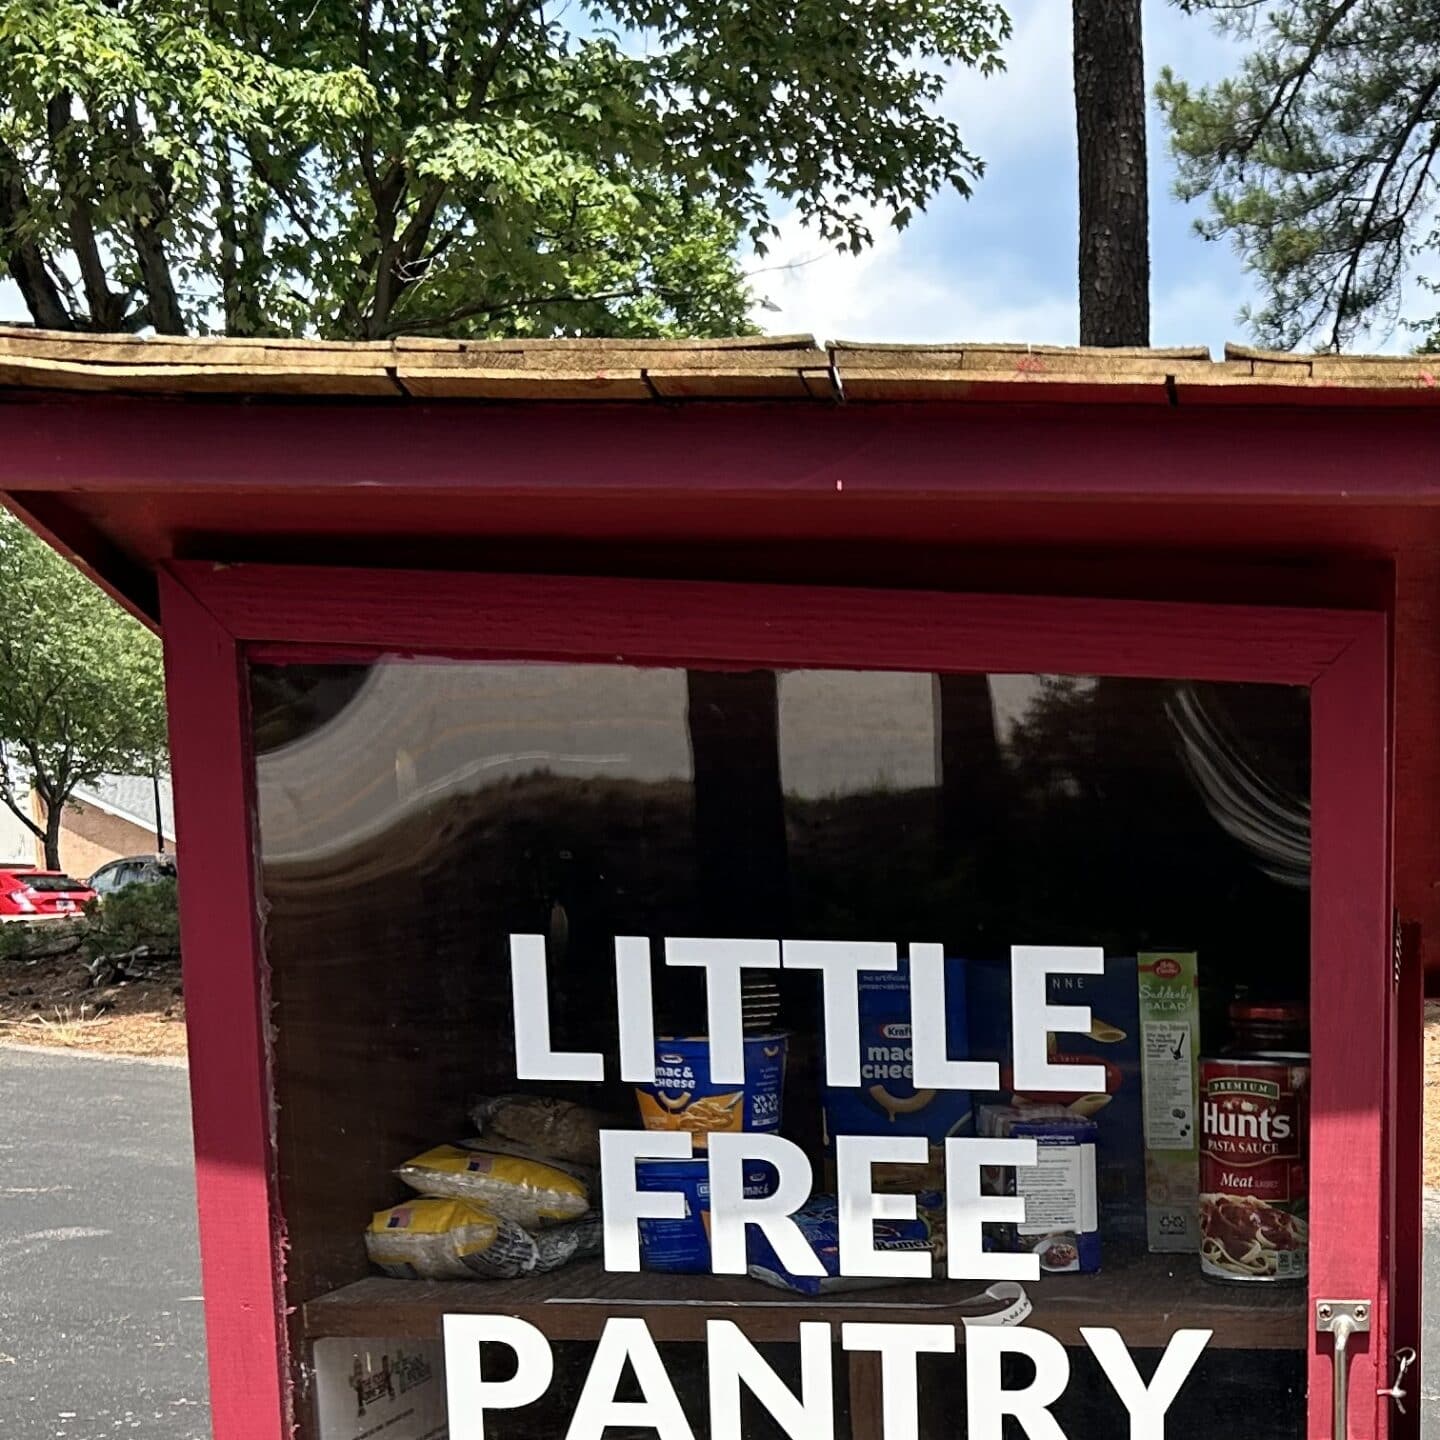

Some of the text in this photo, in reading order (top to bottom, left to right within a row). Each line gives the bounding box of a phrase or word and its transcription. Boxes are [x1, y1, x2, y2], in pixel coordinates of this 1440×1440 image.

[510, 934, 1106, 1092] LITTLE
[888, 1026, 911, 1037] Kraf
[1214, 1081, 1270, 1093] PREMIUM
[1203, 1101, 1292, 1143] Hunt's
[1207, 1138, 1280, 1155] PASTA SAUCE
[1220, 1171, 1255, 1189] Meat
[599, 1129, 1040, 1281] FREE
